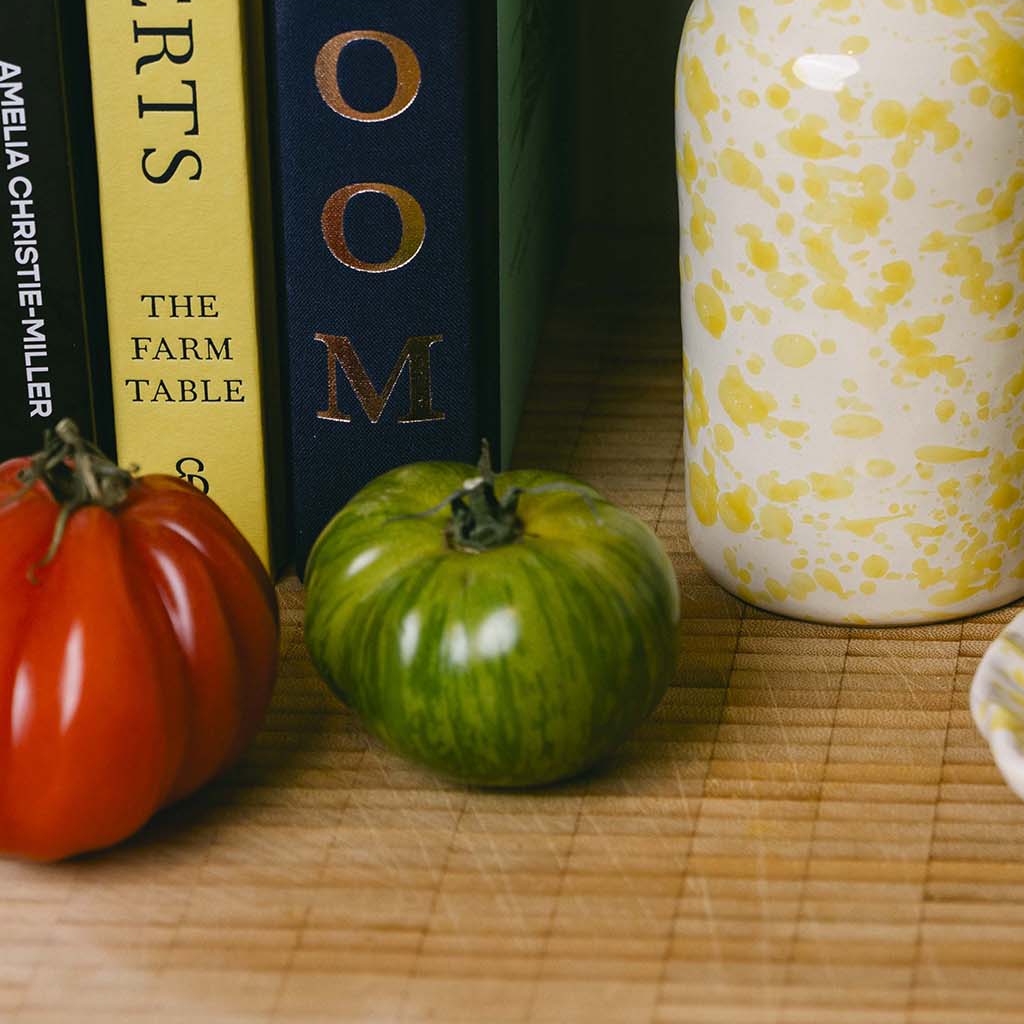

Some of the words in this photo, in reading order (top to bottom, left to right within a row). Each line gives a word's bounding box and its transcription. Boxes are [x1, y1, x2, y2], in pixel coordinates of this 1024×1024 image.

[0, 60, 32, 170] AMELIA
[8, 175, 53, 418] CHRISTIE-MILLER
[140, 294, 219, 318] THE
[130, 336, 234, 360] FARM
[125, 378, 245, 403] TABLE
